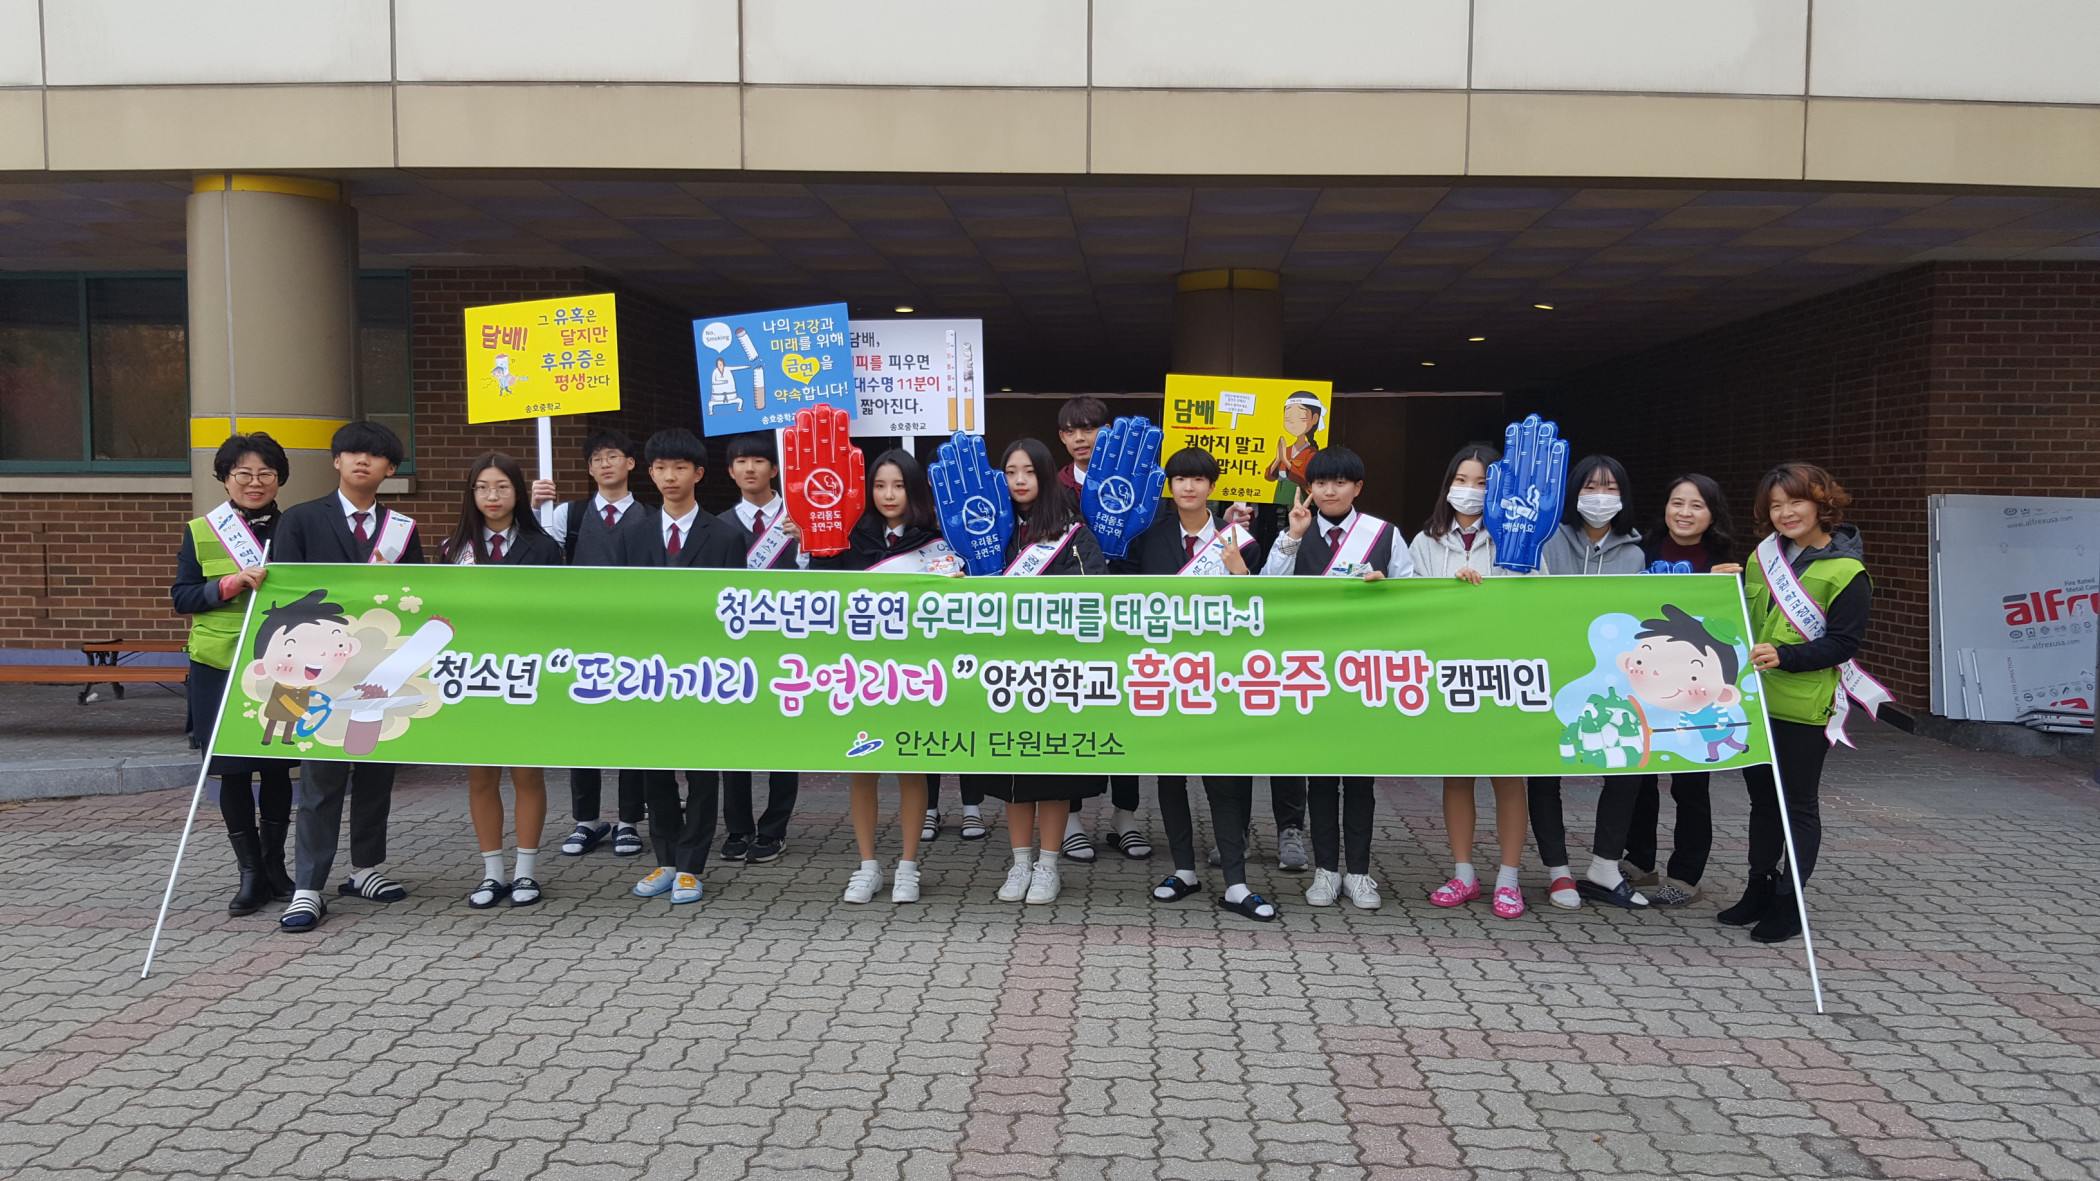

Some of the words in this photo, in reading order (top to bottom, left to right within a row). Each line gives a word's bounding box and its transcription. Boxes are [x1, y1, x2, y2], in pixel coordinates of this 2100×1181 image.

[537, 315, 549, 326] 그
[553, 307, 597, 326] 유혹은
[762, 318, 791, 334] 나의
[793, 317, 834, 335] 건강과
[481, 324, 528, 351] 담배!
[560, 326, 609, 346] 달지만
[770, 336, 812, 353] 미래를
[816, 332, 845, 349] 위해
[541, 350, 606, 371] 후유증은
[852, 355, 883, 371] 피를
[888, 354, 930, 371] 피우면
[554, 373, 610, 392] 평생간다
[854, 376, 894, 393] 대수명
[897, 376, 940, 392] 11분이
[774, 381, 849, 404] 약속합니다!
[525, 402, 561, 413] 송호중학교
[860, 398, 923, 415] 짧아진다.
[1174, 399, 1215, 424] 담배
[890, 422, 927, 431] 송호중학교
[1236, 436, 1265, 454] 말고
[1222, 487, 1261, 497] 송호중학교
[809, 510, 842, 521] 우리몸도
[811, 521, 843, 533] 금연구역
[228, 531, 262, 566] 버스·택시
[970, 533, 999, 549] 우리몸도
[721, 592, 835, 634] 청소년의
[848, 594, 904, 635] 흡연
[917, 596, 1002, 633] 우리의
[1017, 597, 1102, 637] 미래를
[1115, 598, 1260, 638] 태웁니다~!
[434, 655, 537, 699] 청소년
[984, 664, 1117, 707] 양성학교
[1339, 655, 1429, 710] 예방
[1441, 664, 1547, 706] 캠페인
[895, 730, 975, 757] 안산시
[989, 730, 1125, 758] 단원보건소
